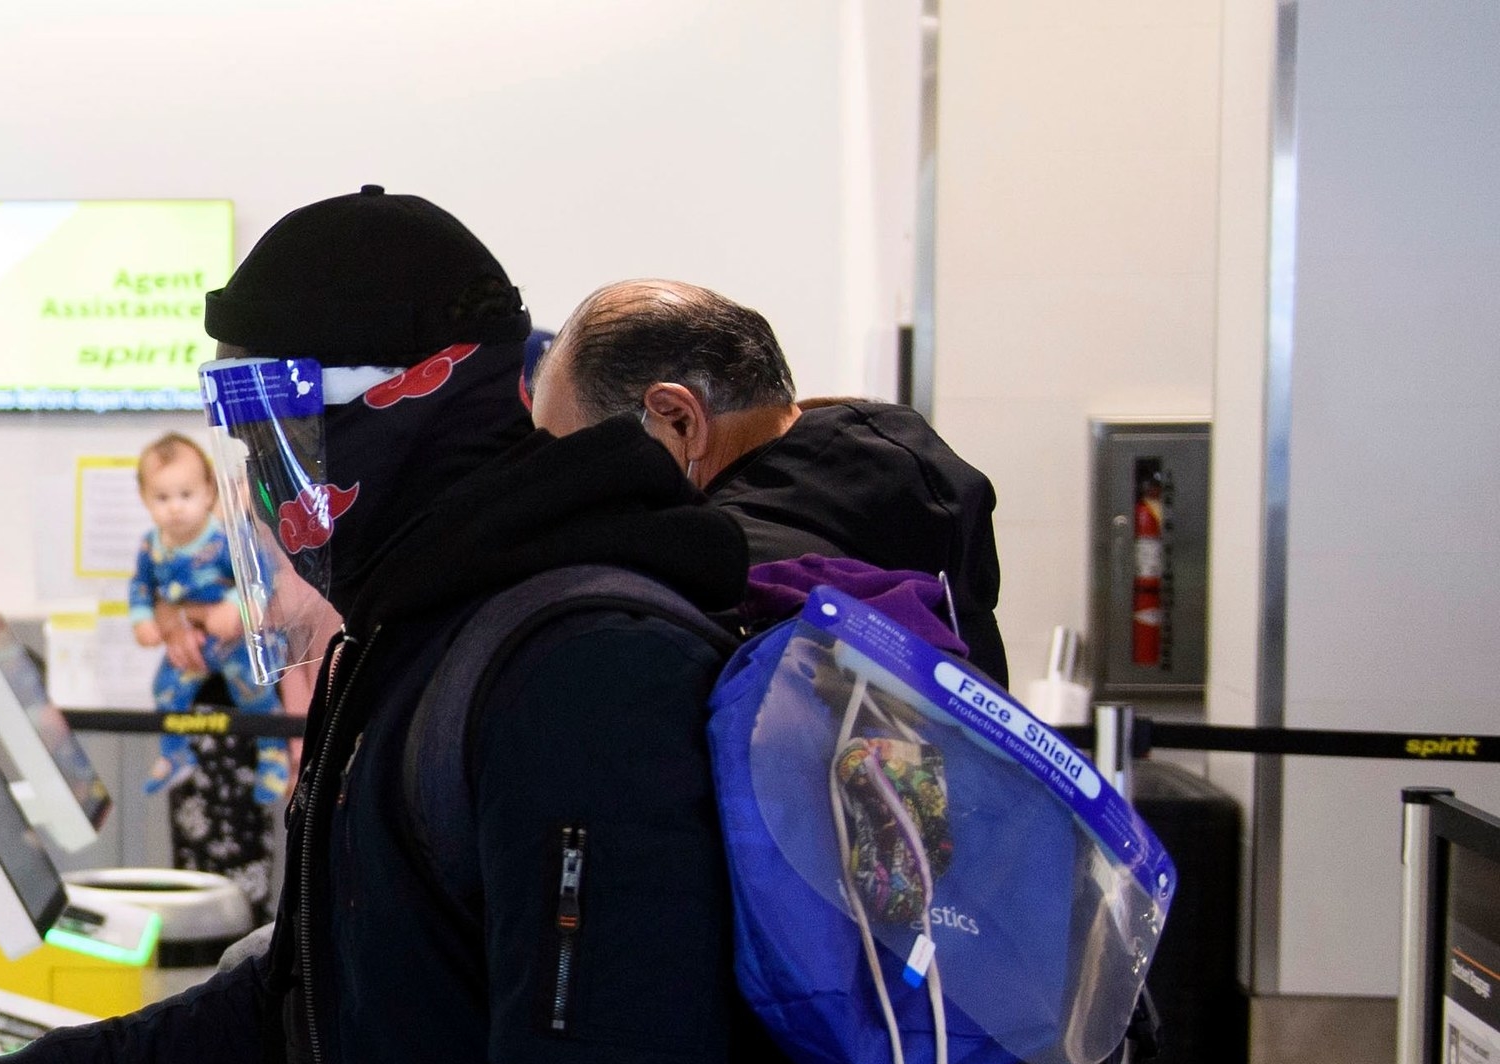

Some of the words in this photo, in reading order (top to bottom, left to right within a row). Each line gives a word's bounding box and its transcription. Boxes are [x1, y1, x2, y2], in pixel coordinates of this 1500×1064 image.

[113, 269, 204, 295] Agent
[41, 298, 203, 318] Assistance
[78, 343, 198, 369] spirit
[958, 678, 1012, 723] Face
[1024, 723, 1083, 780] Shield
[948, 697, 1004, 740] Protective
[1004, 736, 1049, 774] Isolation
[1050, 769, 1075, 799] Mask
[1405, 738, 1478, 757] spirit
